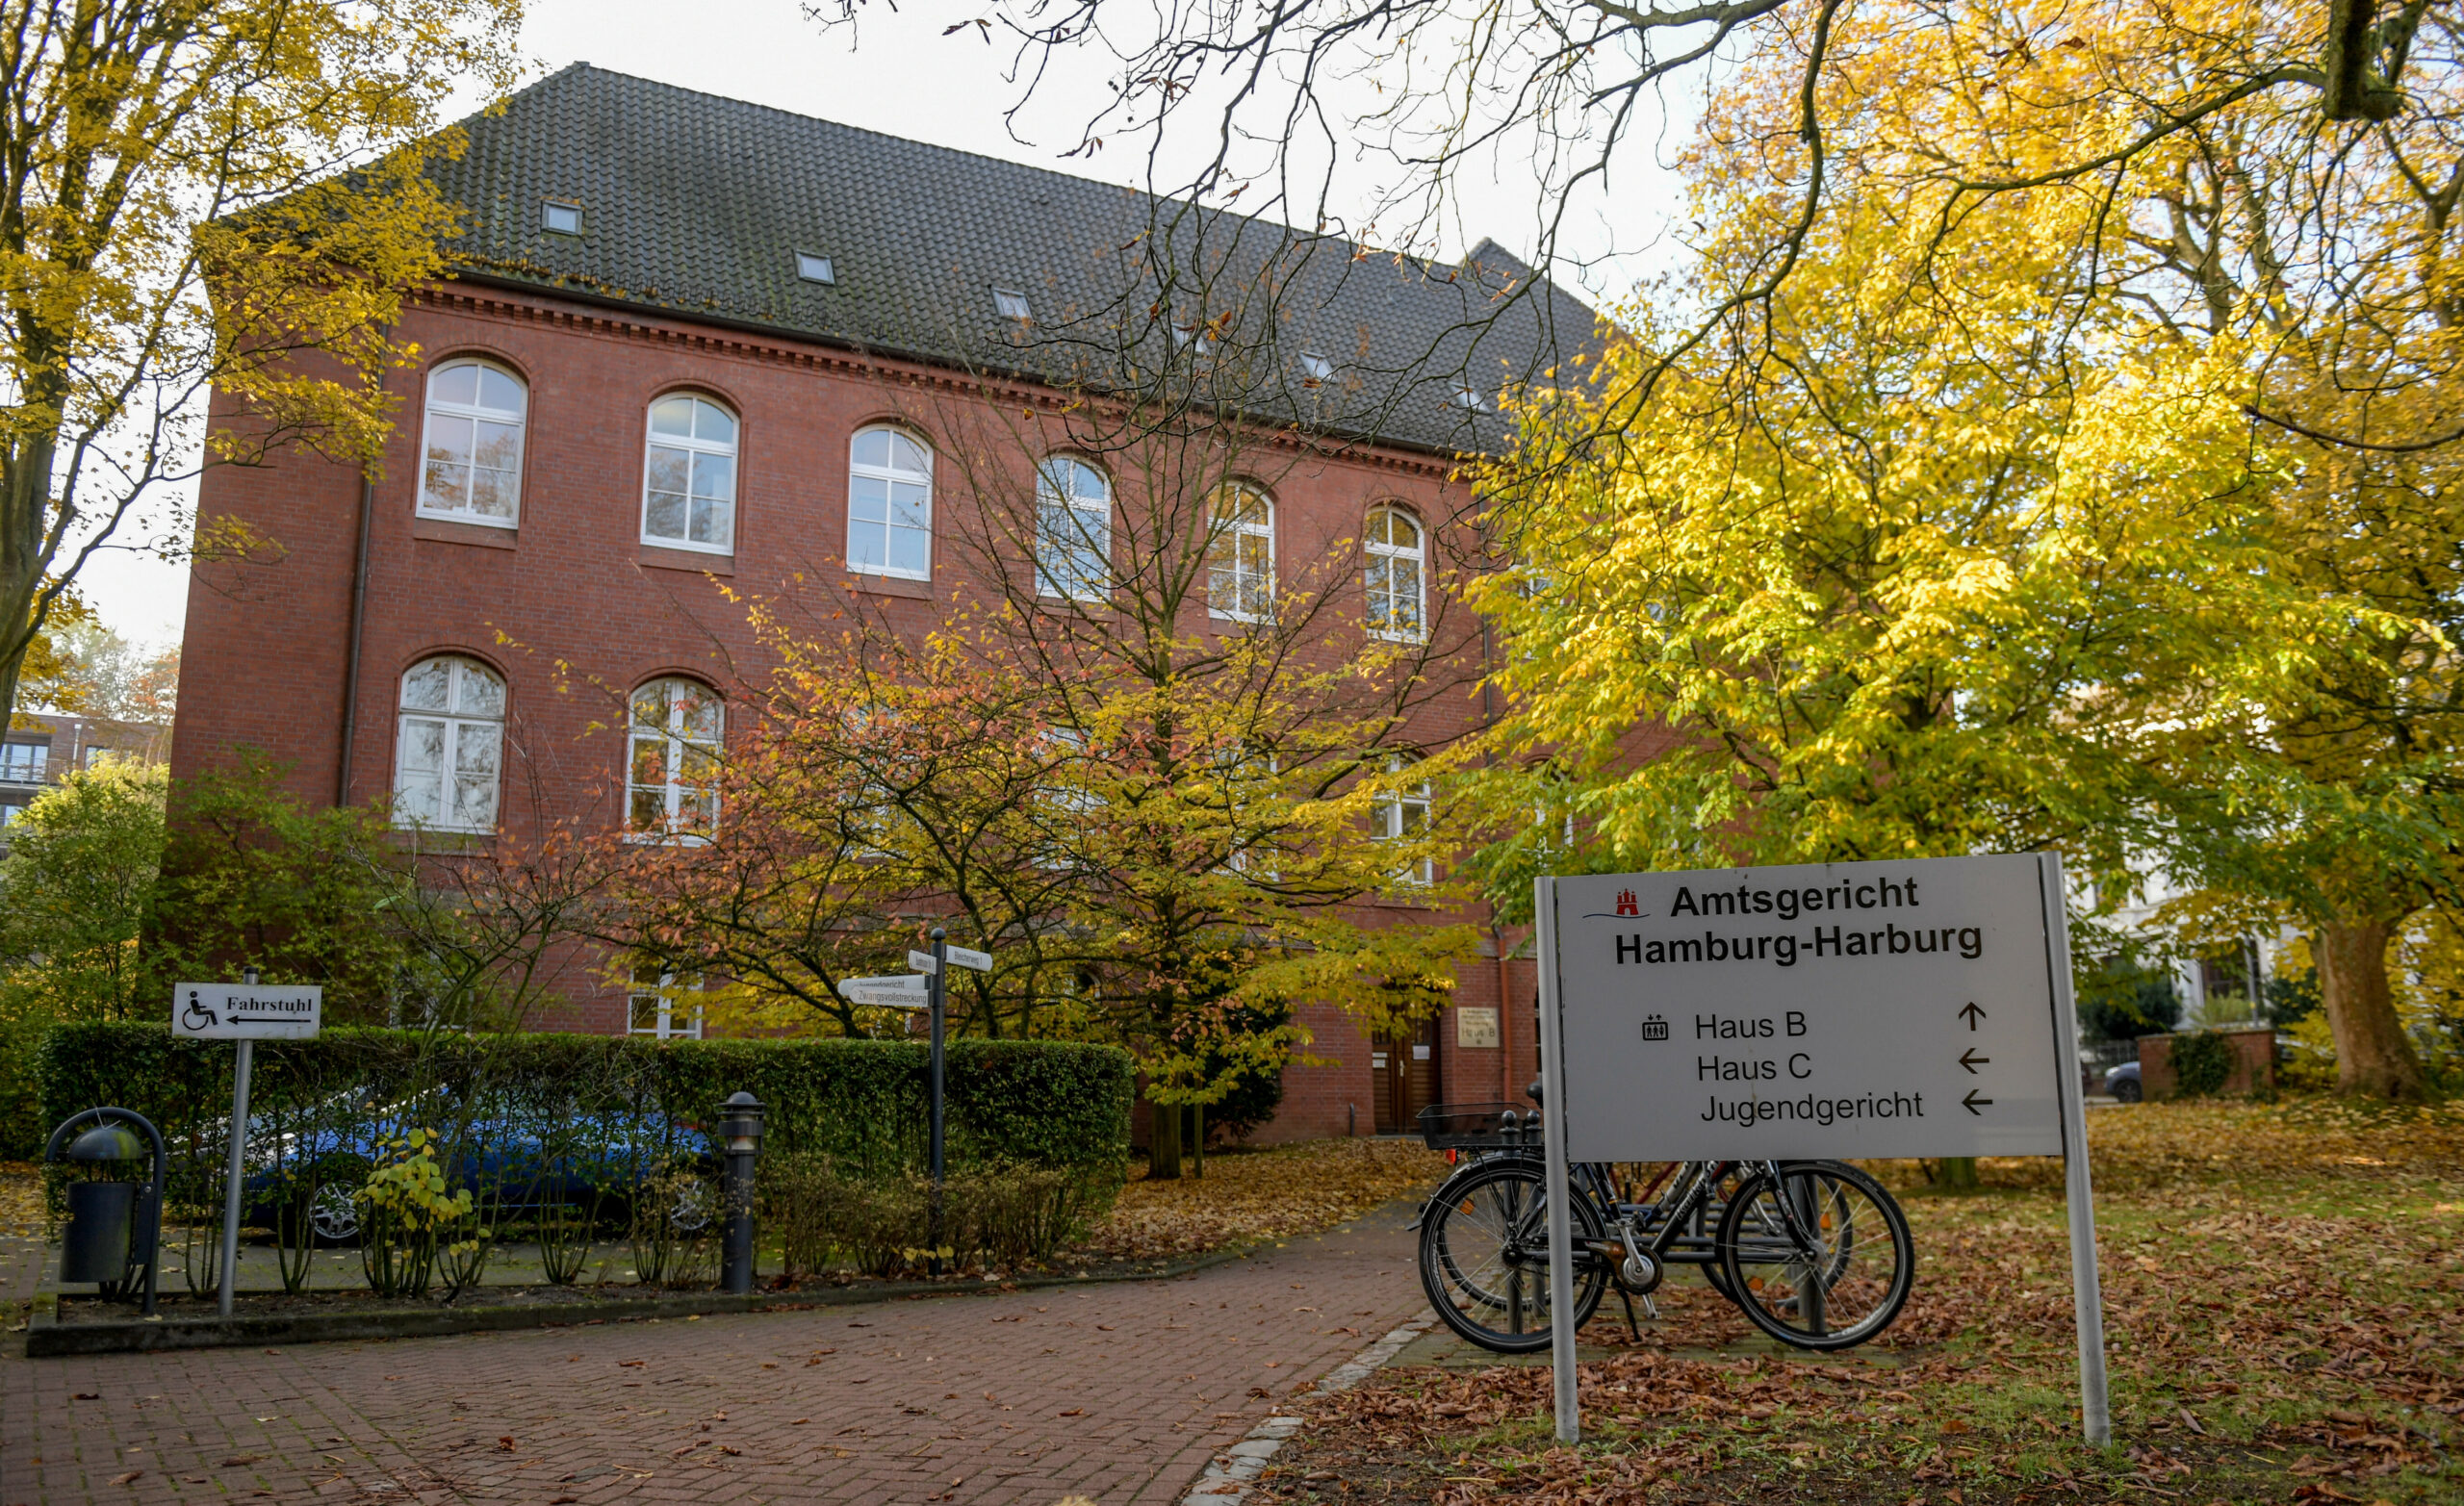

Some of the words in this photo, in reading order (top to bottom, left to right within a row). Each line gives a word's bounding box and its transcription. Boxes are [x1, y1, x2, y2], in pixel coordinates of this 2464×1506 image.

[1671, 877, 1919, 920] Amtsgericht
[1615, 924, 1983, 966] Hamburg-Harburg
[226, 996, 312, 1011] Fahrstuhl
[859, 990, 927, 1004] Zwangsvollstreckung
[1462, 1028, 1484, 1037] Haus
[1489, 1028, 1495, 1037] B
[1695, 1013, 1775, 1039] Haus
[1786, 1011, 1808, 1037] B
[1698, 1057, 1777, 1081] Haus
[1788, 1053, 1812, 1080] C
[1701, 1092, 1923, 1126] Jugendgericht
